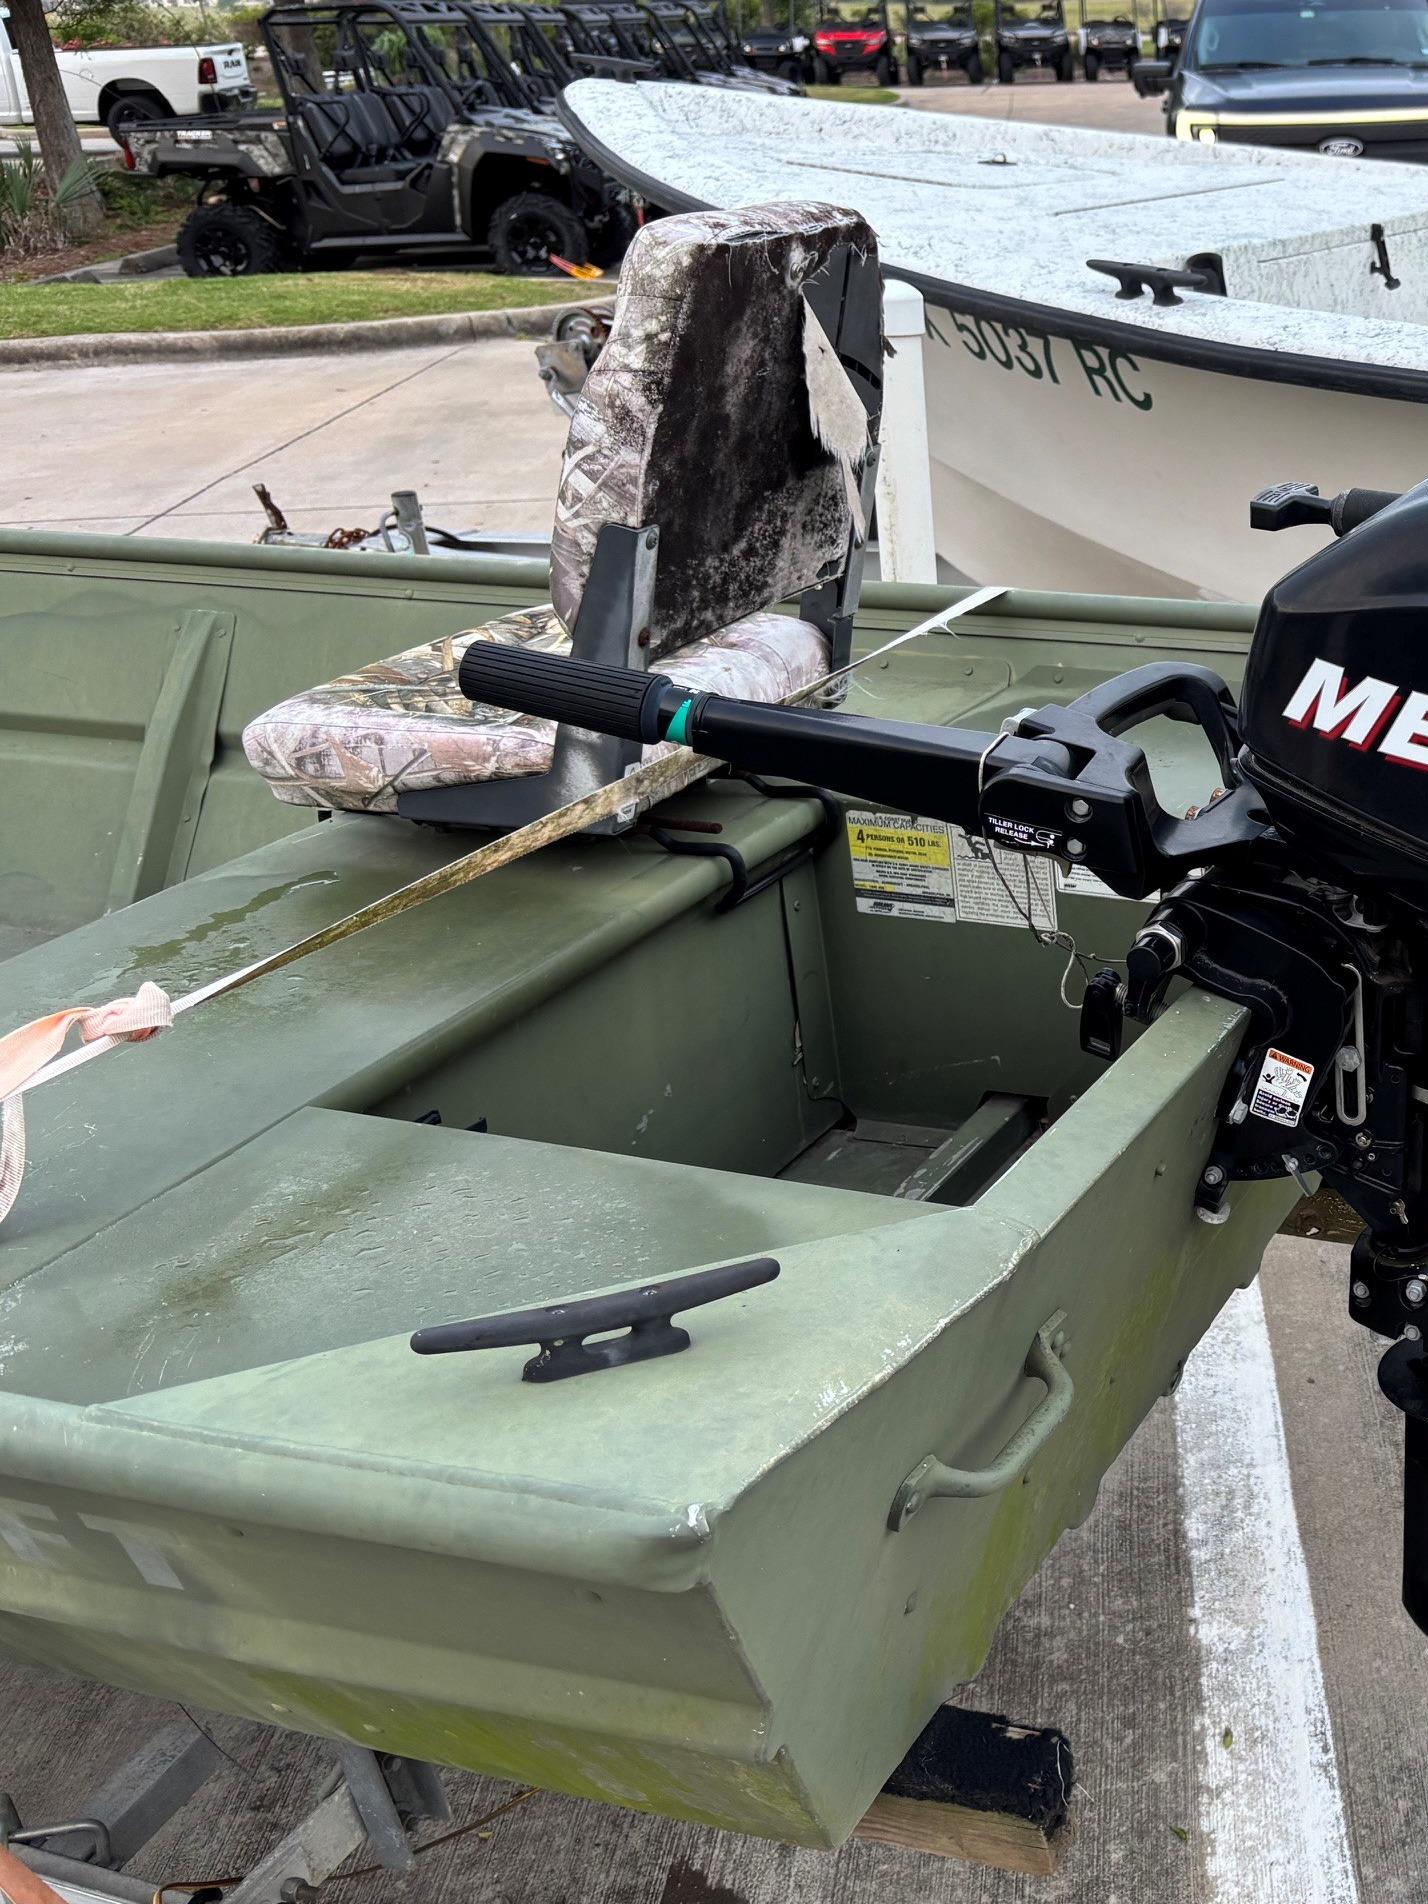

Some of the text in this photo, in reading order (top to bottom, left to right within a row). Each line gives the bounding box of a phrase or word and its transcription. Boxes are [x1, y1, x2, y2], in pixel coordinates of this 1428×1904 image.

[223, 60, 241, 69] RAM
[1071, 339, 1153, 411] RC
[848, 817, 892, 829] MAXIMUM
[893, 820, 945, 834] CAPACITIES
[988, 817, 1035, 834] TILLER LOCK
[995, 826, 1028, 839] RELEASE
[857, 829, 866, 844] 4
[866, 833, 895, 843] PERSONS
[896, 836, 905, 844] OR
[907, 836, 926, 848] 510
[1280, 1056, 1311, 1073] WARNING
